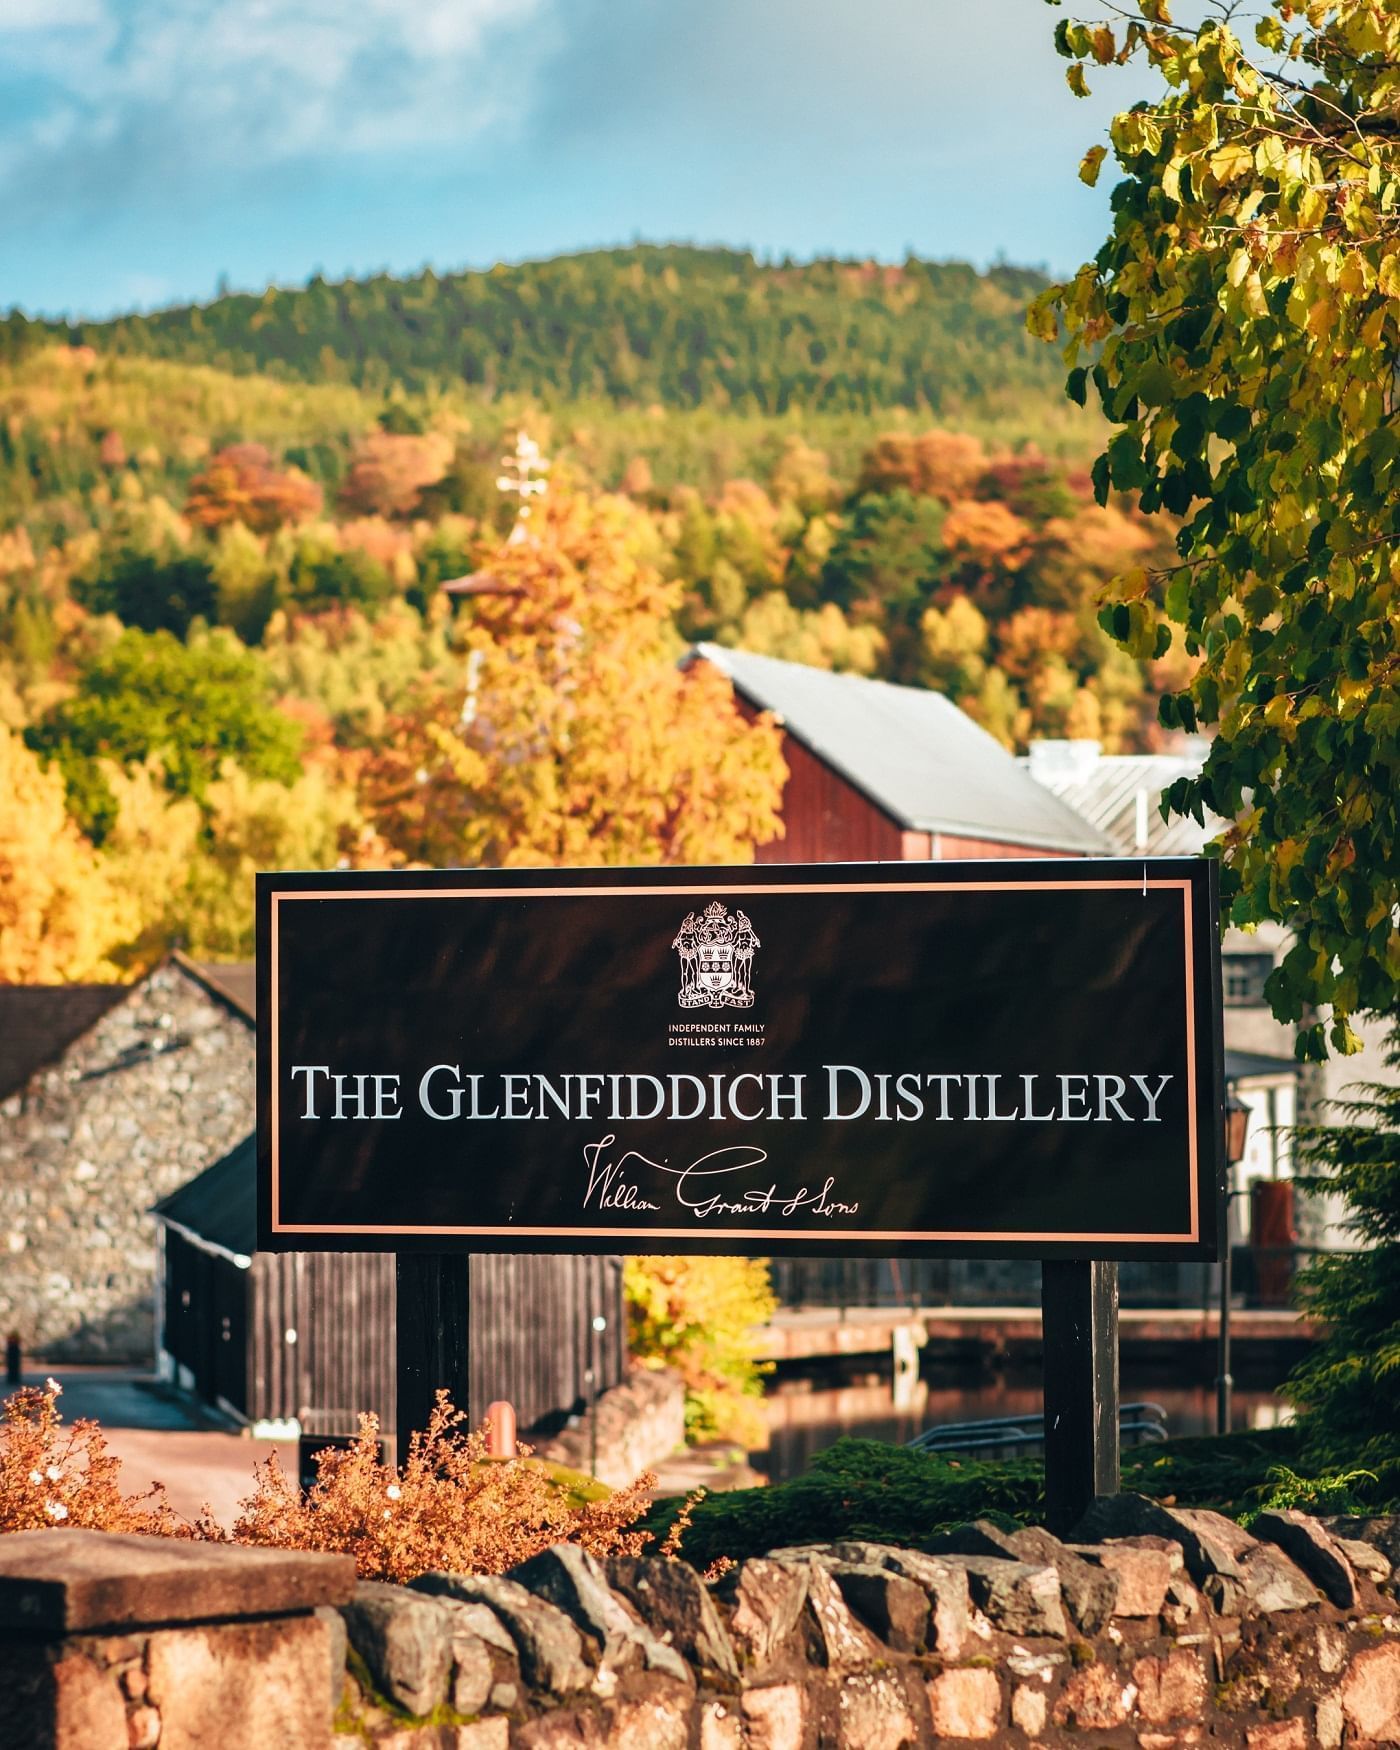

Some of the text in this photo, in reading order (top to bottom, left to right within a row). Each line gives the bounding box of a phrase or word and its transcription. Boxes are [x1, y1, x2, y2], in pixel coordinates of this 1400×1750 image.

[681, 996, 752, 1007] STAND FAST
[668, 1023, 765, 1033] INDEPENDENT FAMILY
[668, 1037, 716, 1047] DISTILLERS
[718, 1037, 744, 1047] SINCE
[290, 1064, 1174, 1123] THE GLENFIDDICH DISTILLERY
[811, 1176, 860, 1218] Sons
